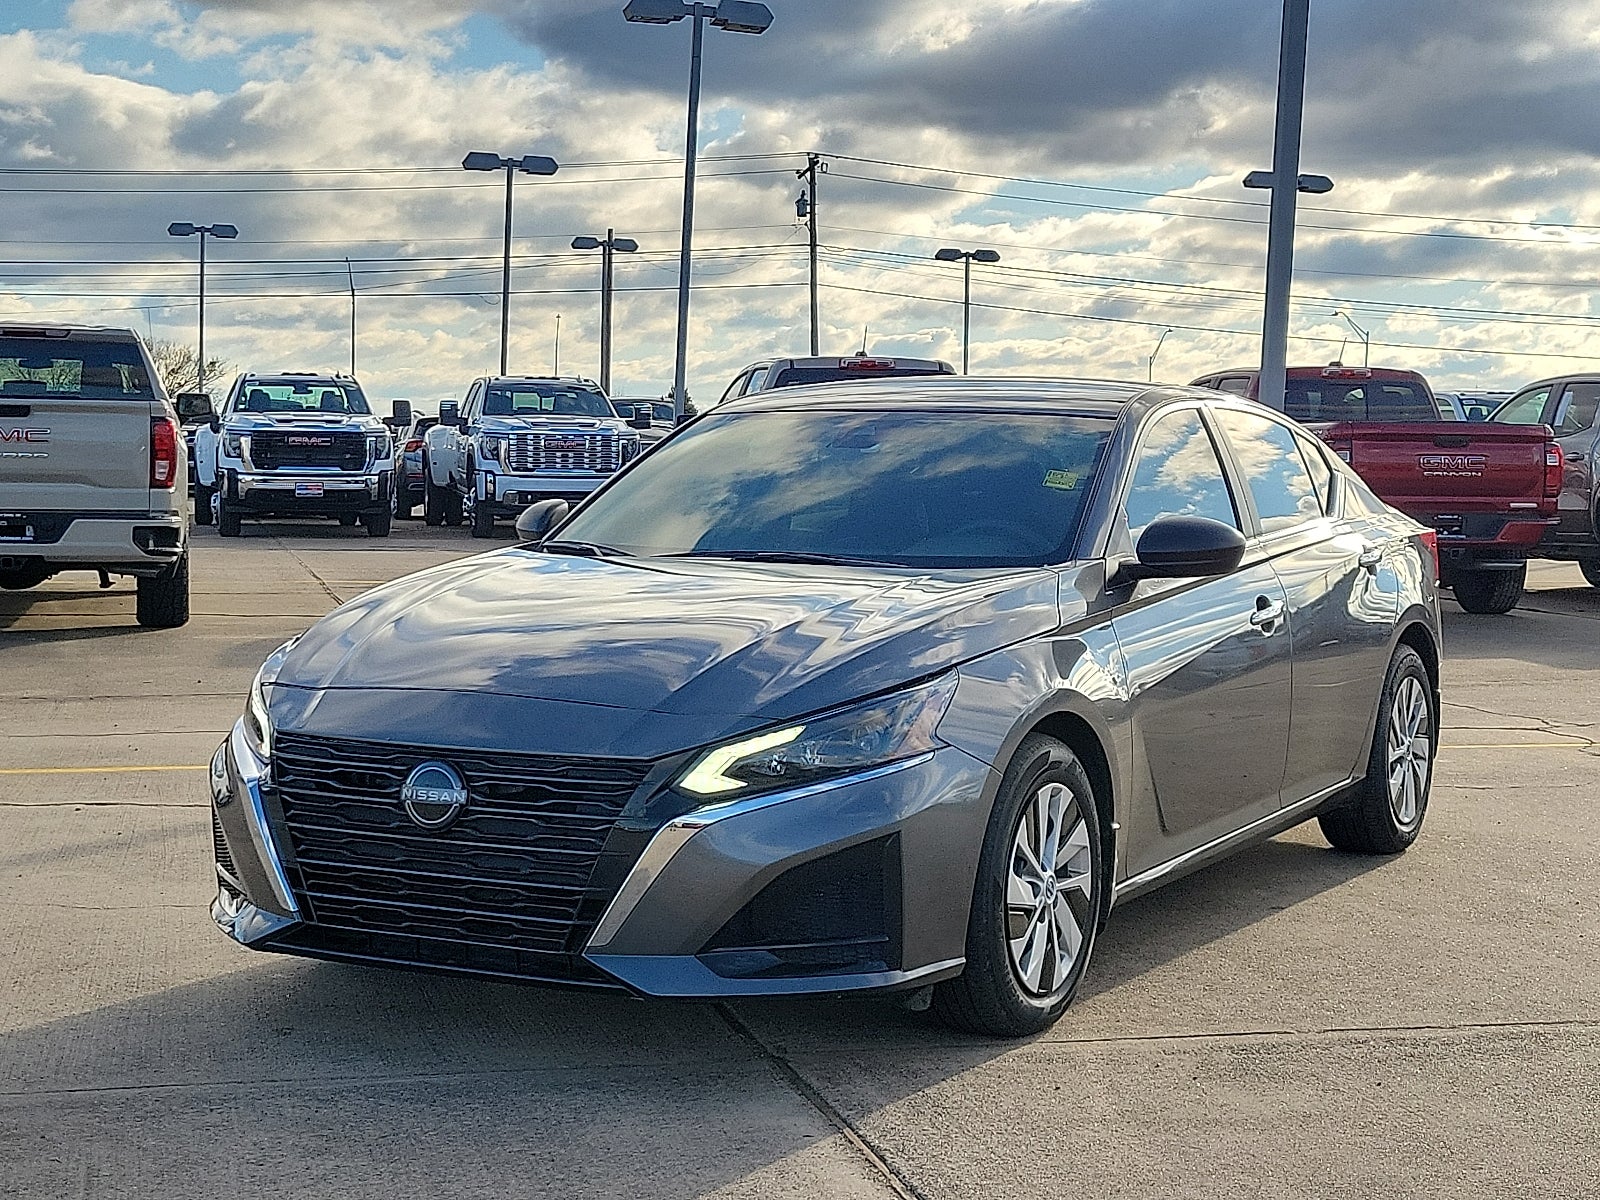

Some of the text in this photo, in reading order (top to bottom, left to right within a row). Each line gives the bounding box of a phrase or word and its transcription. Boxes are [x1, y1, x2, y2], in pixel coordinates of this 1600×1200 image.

[0, 428, 51, 443] MC
[289, 437, 331, 446] GMC
[1420, 456, 1486, 469] GMC
[402, 788, 465, 802] NISSAN
